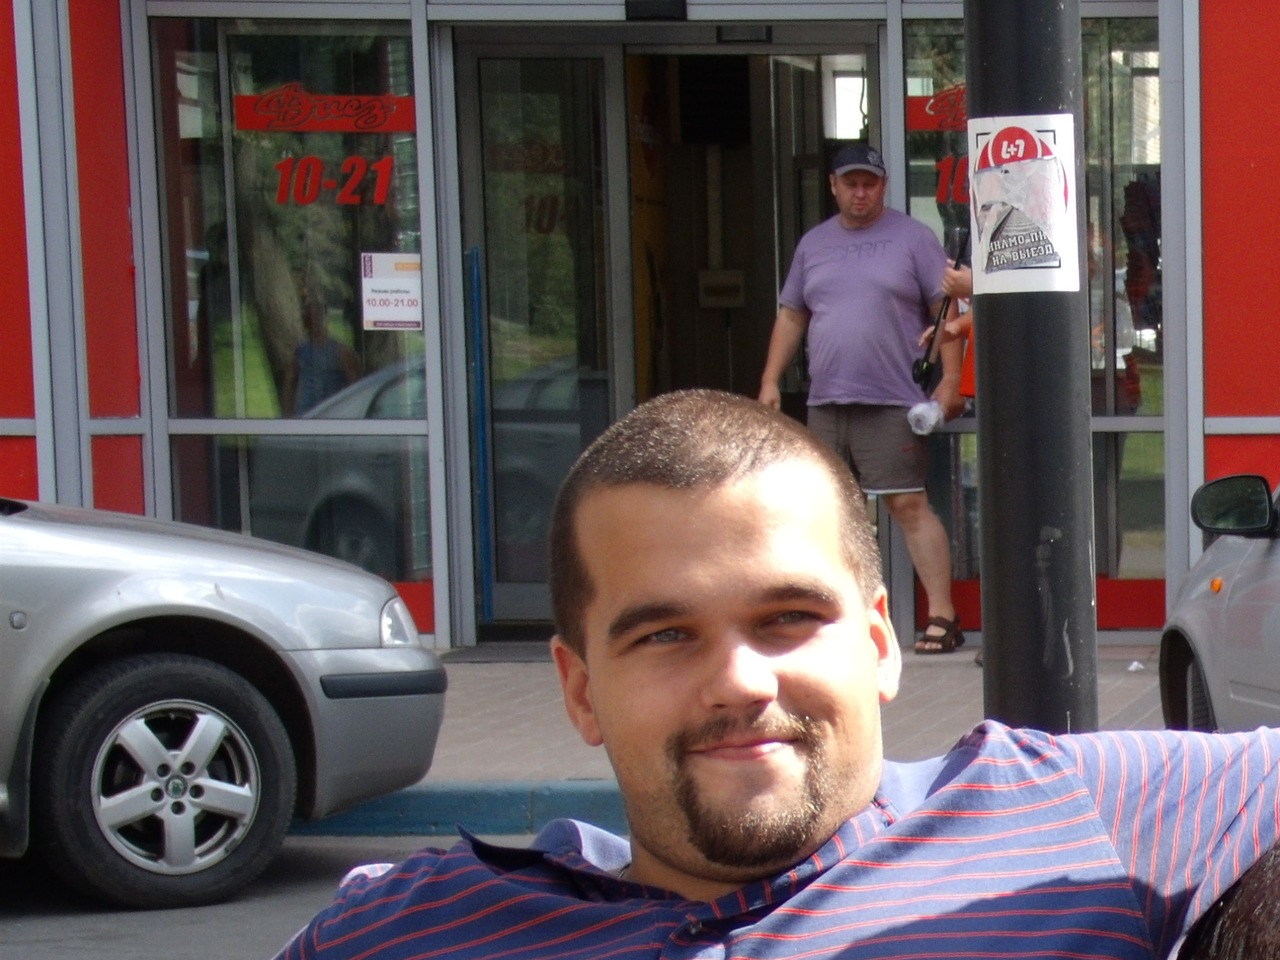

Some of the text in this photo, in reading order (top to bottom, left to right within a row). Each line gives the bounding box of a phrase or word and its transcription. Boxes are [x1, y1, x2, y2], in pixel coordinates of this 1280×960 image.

[274, 154, 394, 206] 10-21
[992, 254, 1007, 266] НА
[367, 298, 418, 307] 10.00-21.00
